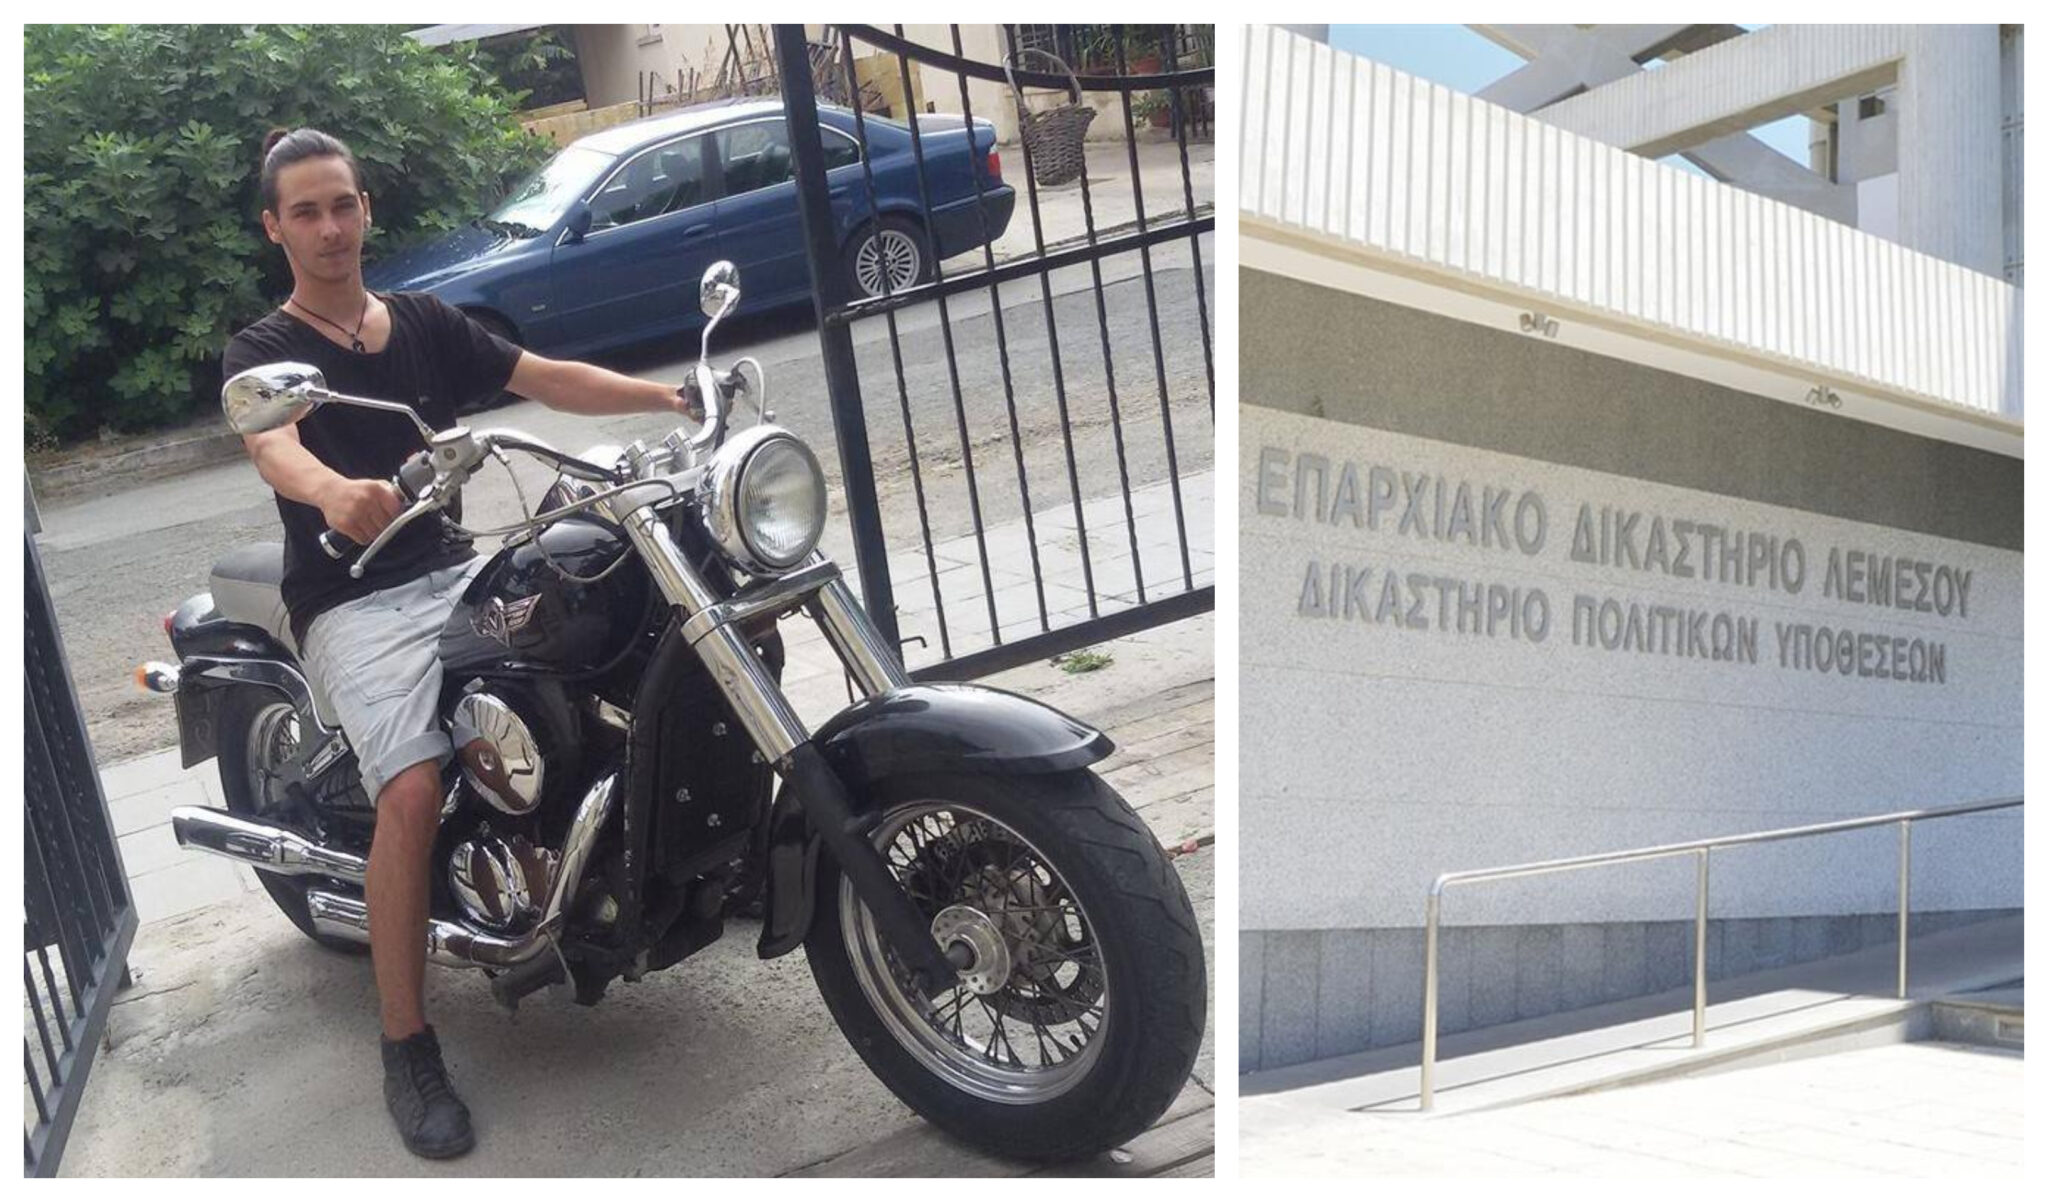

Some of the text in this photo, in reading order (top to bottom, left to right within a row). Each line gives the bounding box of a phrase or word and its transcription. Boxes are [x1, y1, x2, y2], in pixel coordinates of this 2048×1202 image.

[1256, 445, 1973, 618] ΕΠΑΡΧΙΑΚΟ ΔΙΚΑΣΤΗΡΙΟ ΛΕΜΕΣΟΥ
[1298, 560, 1946, 684] ΔΙΚΑΣΤΗΡΙΟ ΠΟΛΙΤΙΚΩΝ ΥΠΟΘΕΣΕΩΝ
